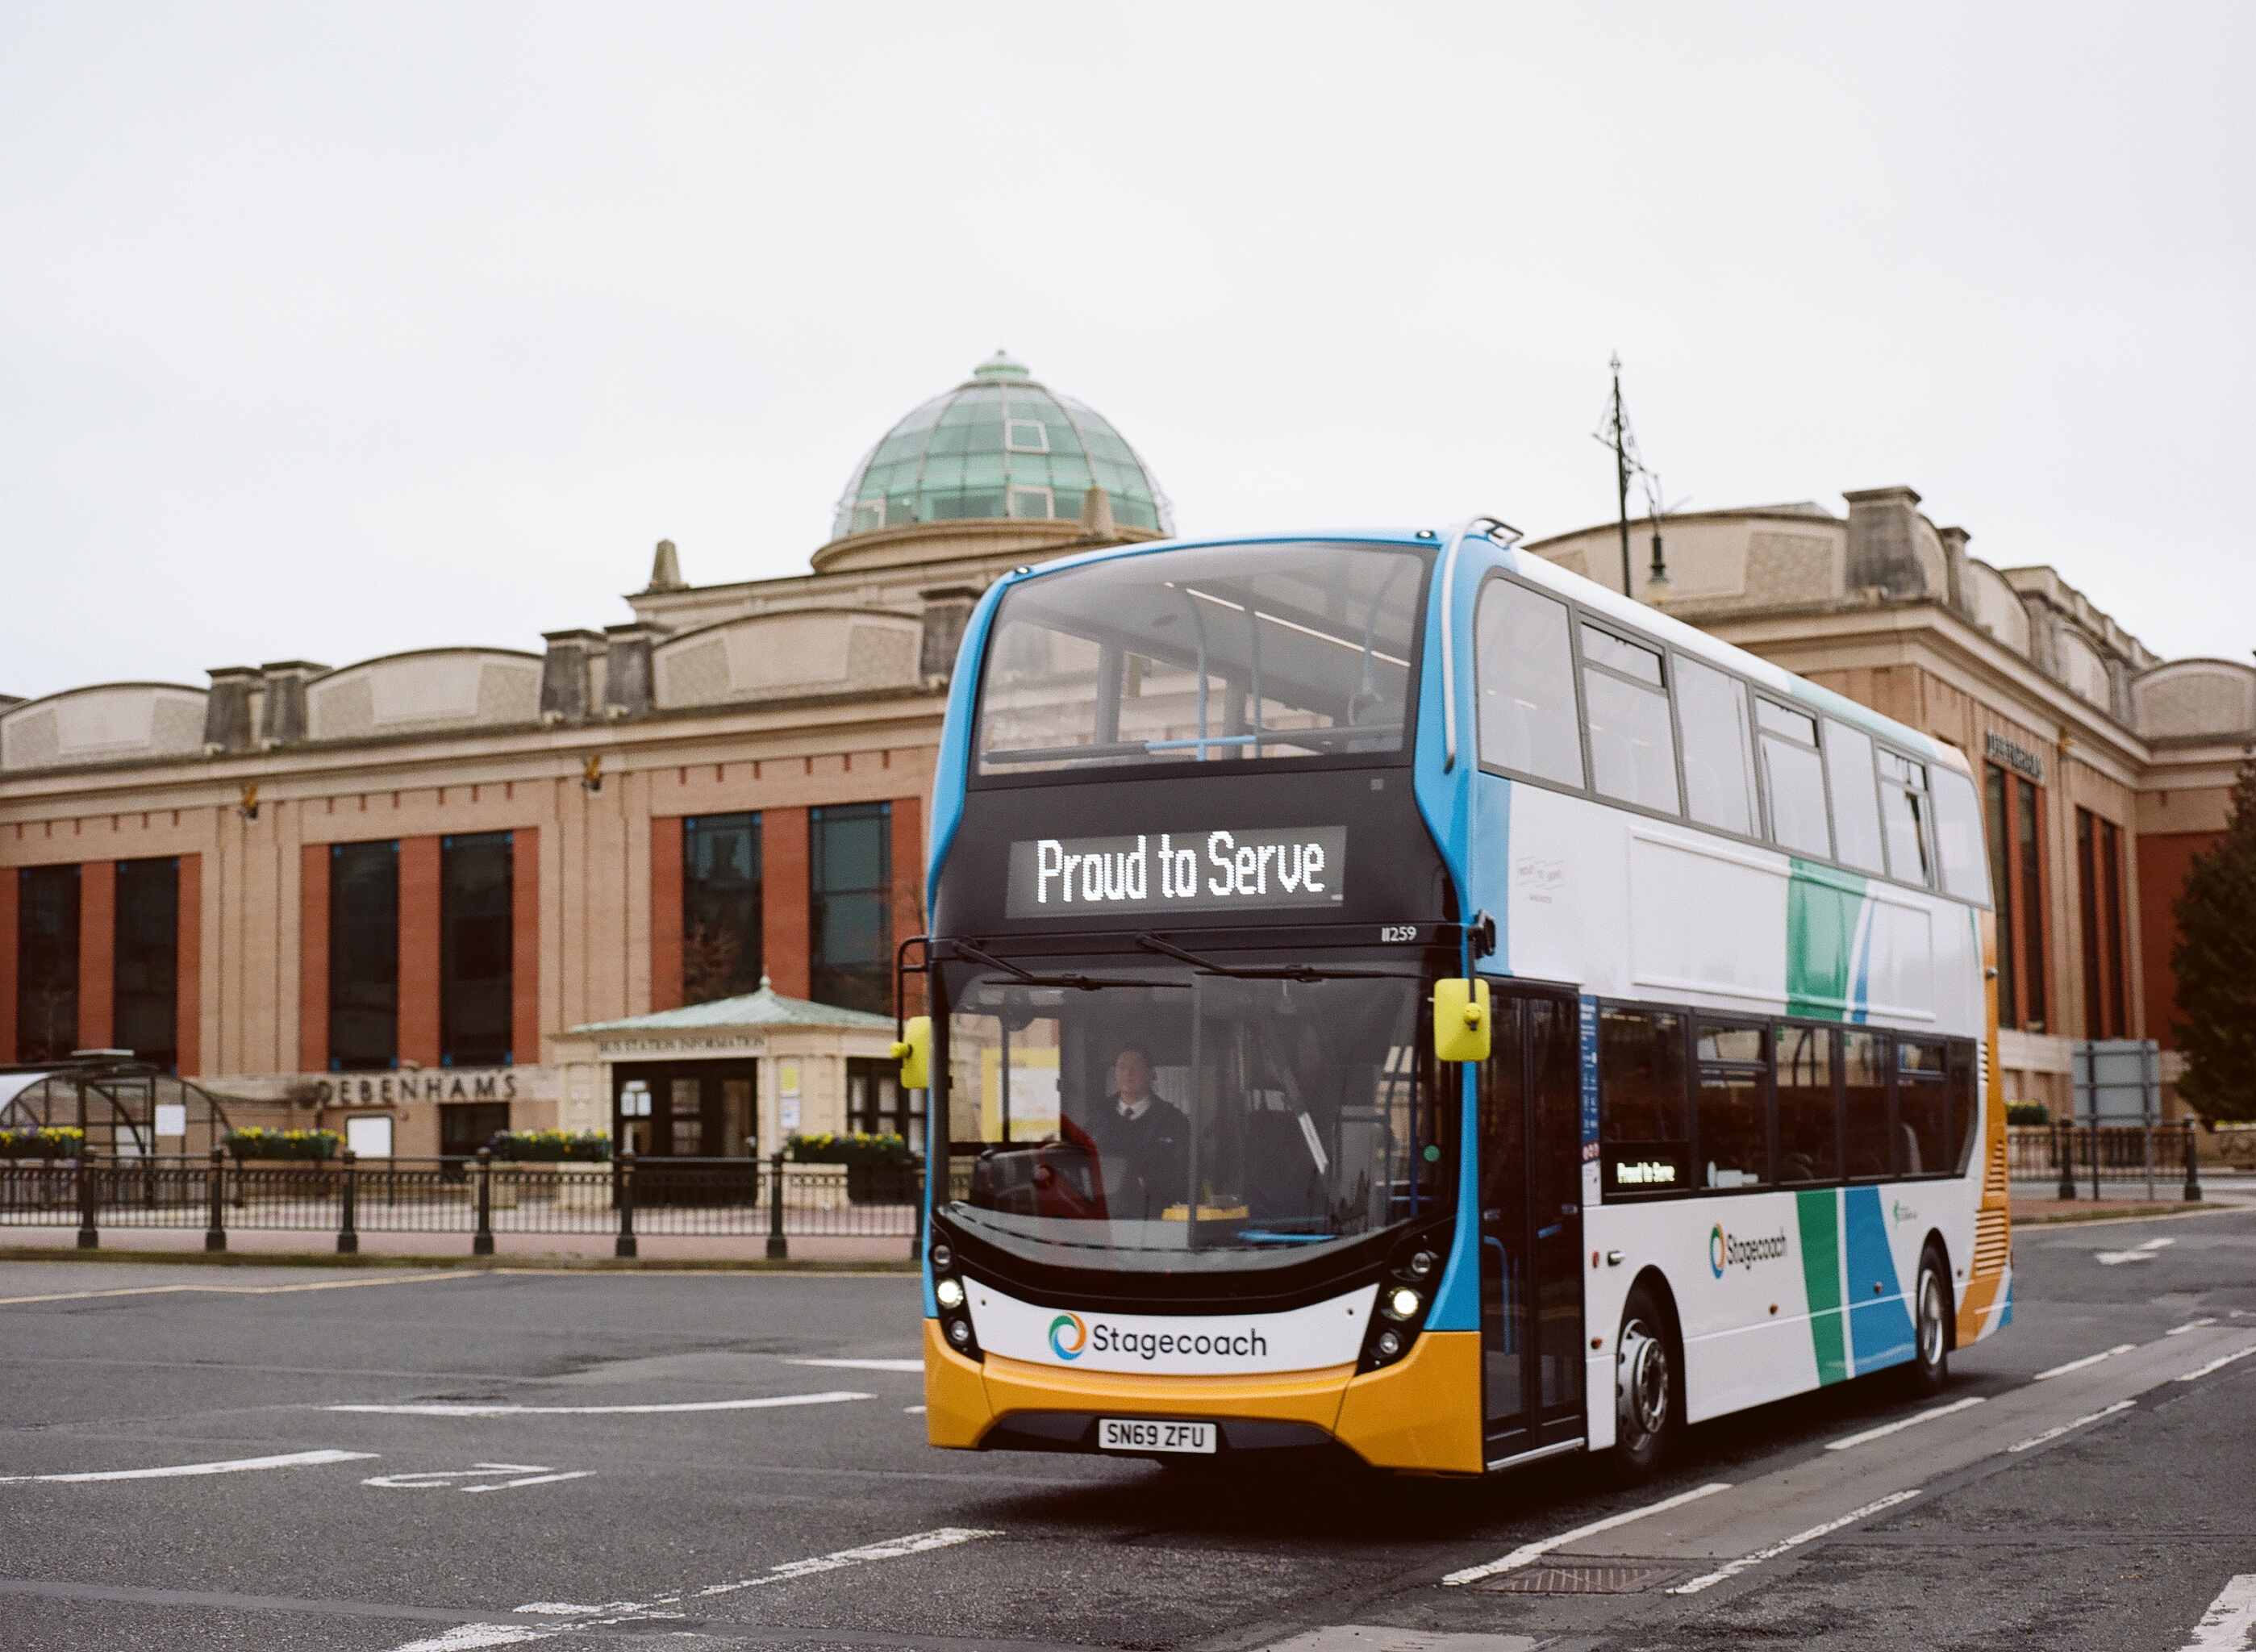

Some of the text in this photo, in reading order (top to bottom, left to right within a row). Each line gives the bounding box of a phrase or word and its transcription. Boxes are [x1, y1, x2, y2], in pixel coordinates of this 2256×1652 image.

[1037, 831, 1325, 903] Proud to Serve
[1382, 925, 1416, 942] 11259
[318, 1074, 517, 1105] DEBENHAMS
[1727, 1226, 1787, 1270] Stagecoach
[1093, 1325, 1267, 1360] Stagecoach
[1107, 1424, 1204, 1447] SN69 ZFU
